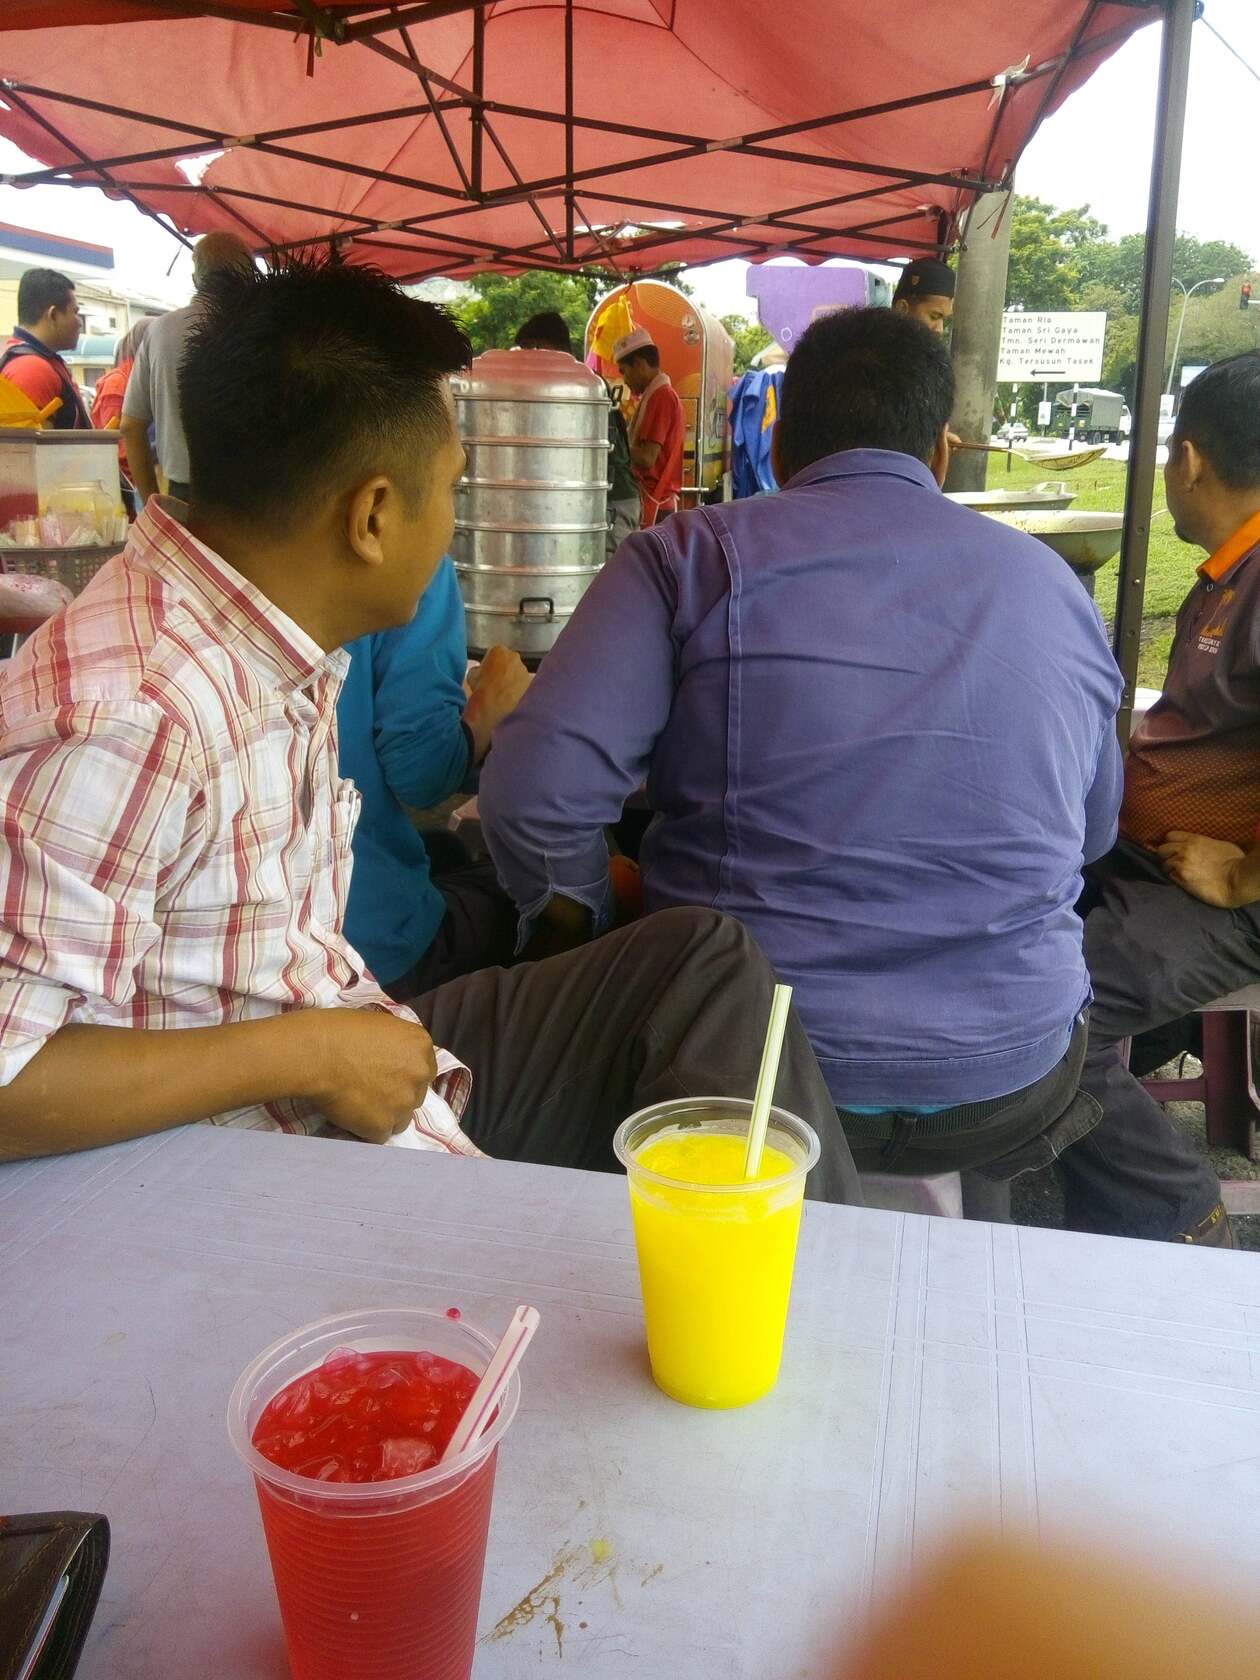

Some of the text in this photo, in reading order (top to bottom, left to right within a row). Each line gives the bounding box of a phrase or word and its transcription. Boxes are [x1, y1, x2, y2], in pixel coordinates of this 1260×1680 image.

[1002, 326, 1032, 334] Taman
[1037, 326, 1050, 334] Sri
[1028, 336, 1046, 344] Seri
